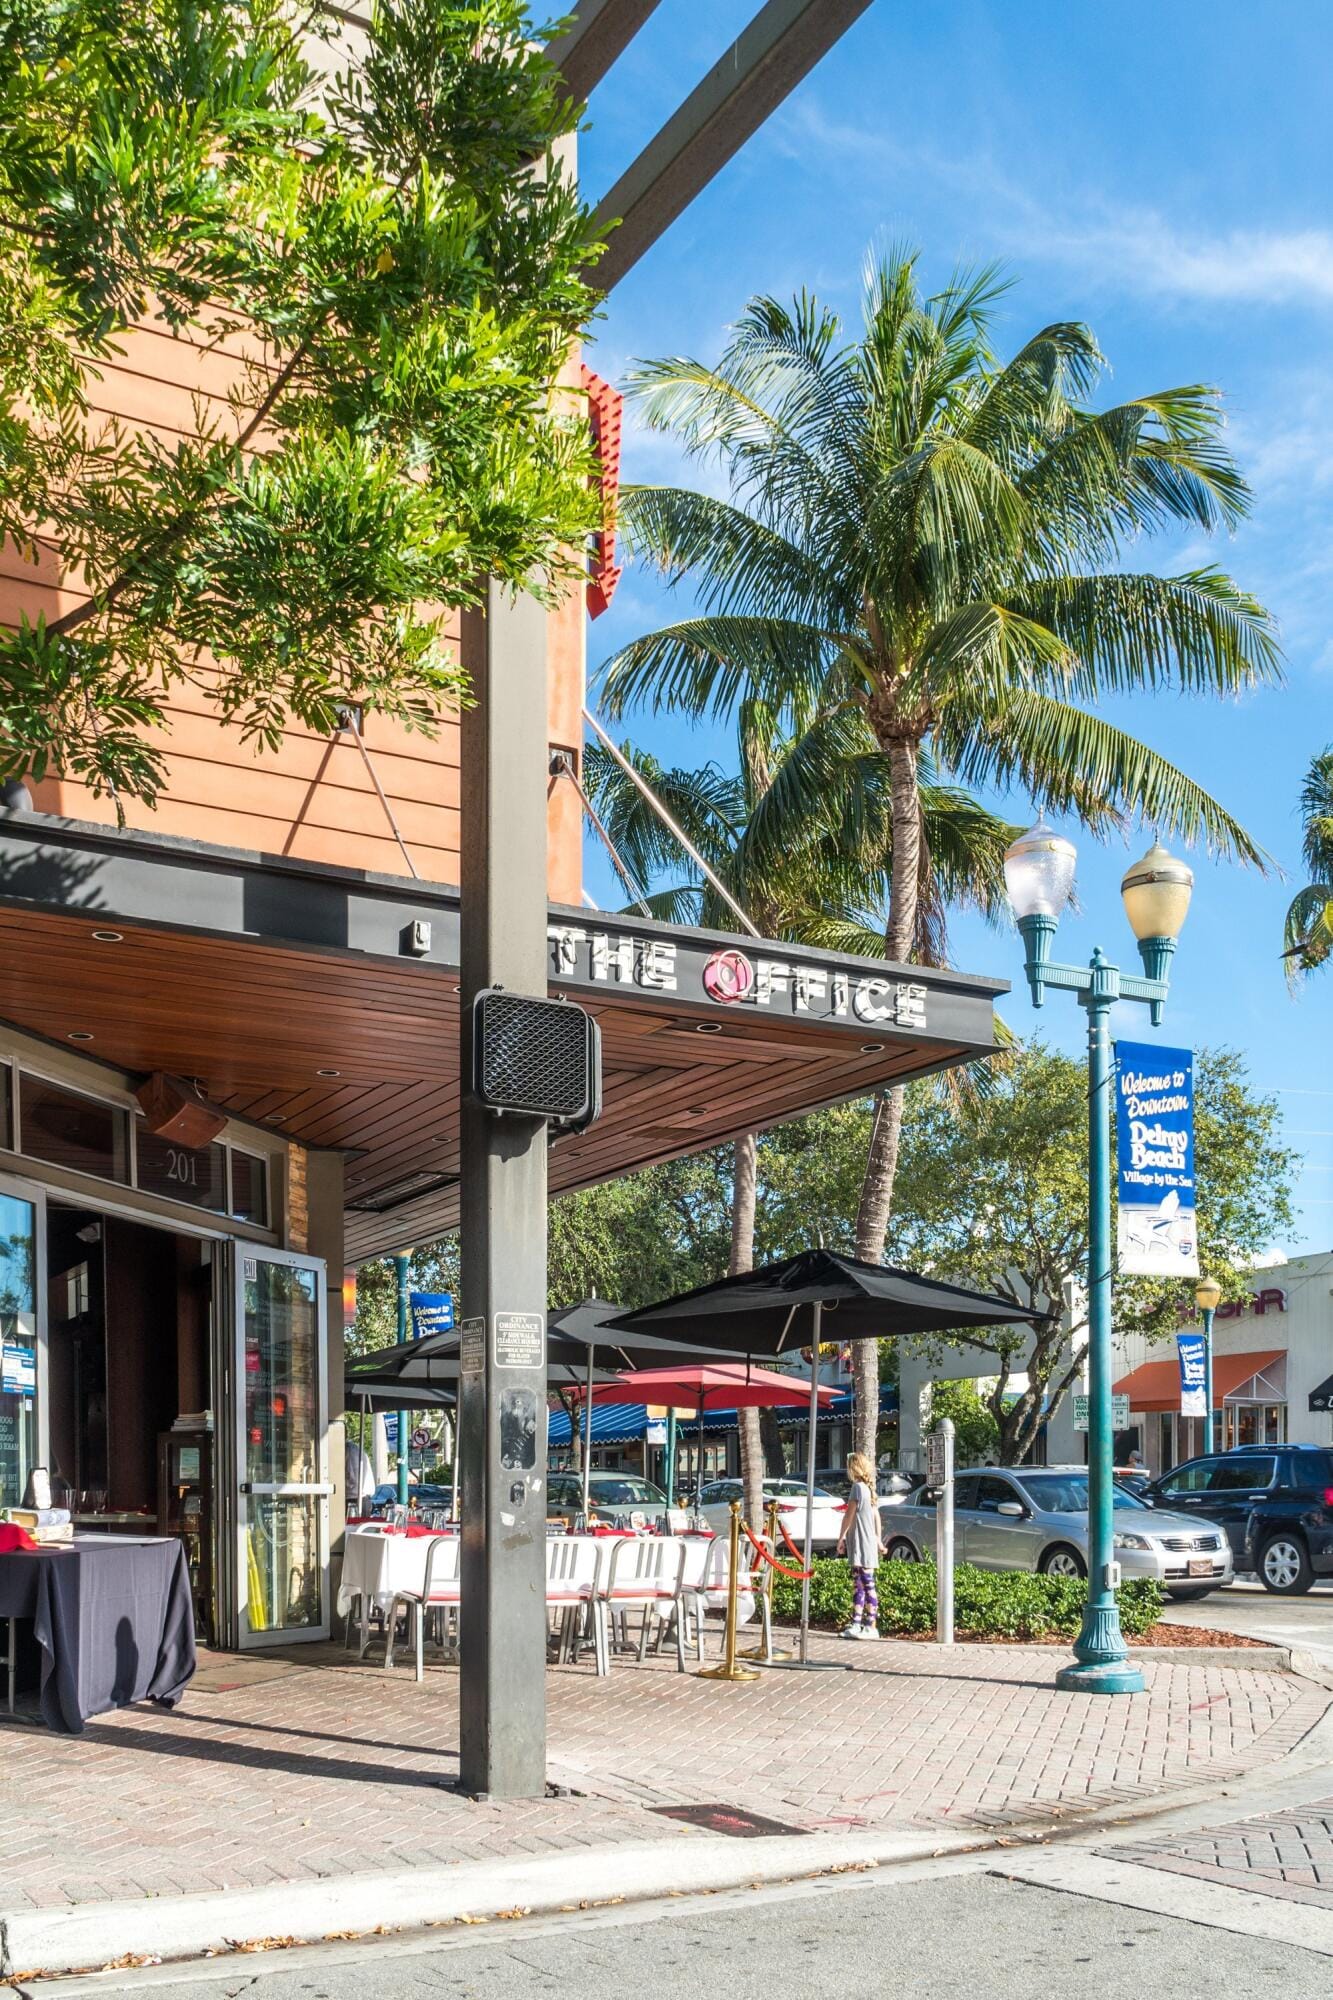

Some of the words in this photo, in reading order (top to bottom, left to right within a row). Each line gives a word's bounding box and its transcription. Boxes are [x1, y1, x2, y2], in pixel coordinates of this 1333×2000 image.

[547, 926, 677, 990] THE
[702, 950, 927, 1028] OFFICE
[1121, 1071, 1171, 1095] Welcome
[1172, 1071, 1185, 1088] to
[1125, 1094, 1189, 1119] Downtown
[1129, 1121, 1188, 1153] Delray
[167, 1149, 198, 1186] 201
[1130, 1143, 1186, 1170] Beach
[1123, 1170, 1154, 1186] Village
[1154, 1172, 1164, 1187] by
[1165, 1173, 1179, 1185] the
[1178, 1174, 1193, 1188] Sea
[413, 1305, 442, 1317] Welcome
[441, 1305, 450, 1314] to
[416, 1315, 451, 1326] Downtown
[498, 1322, 540, 1330] ORDINANCE
